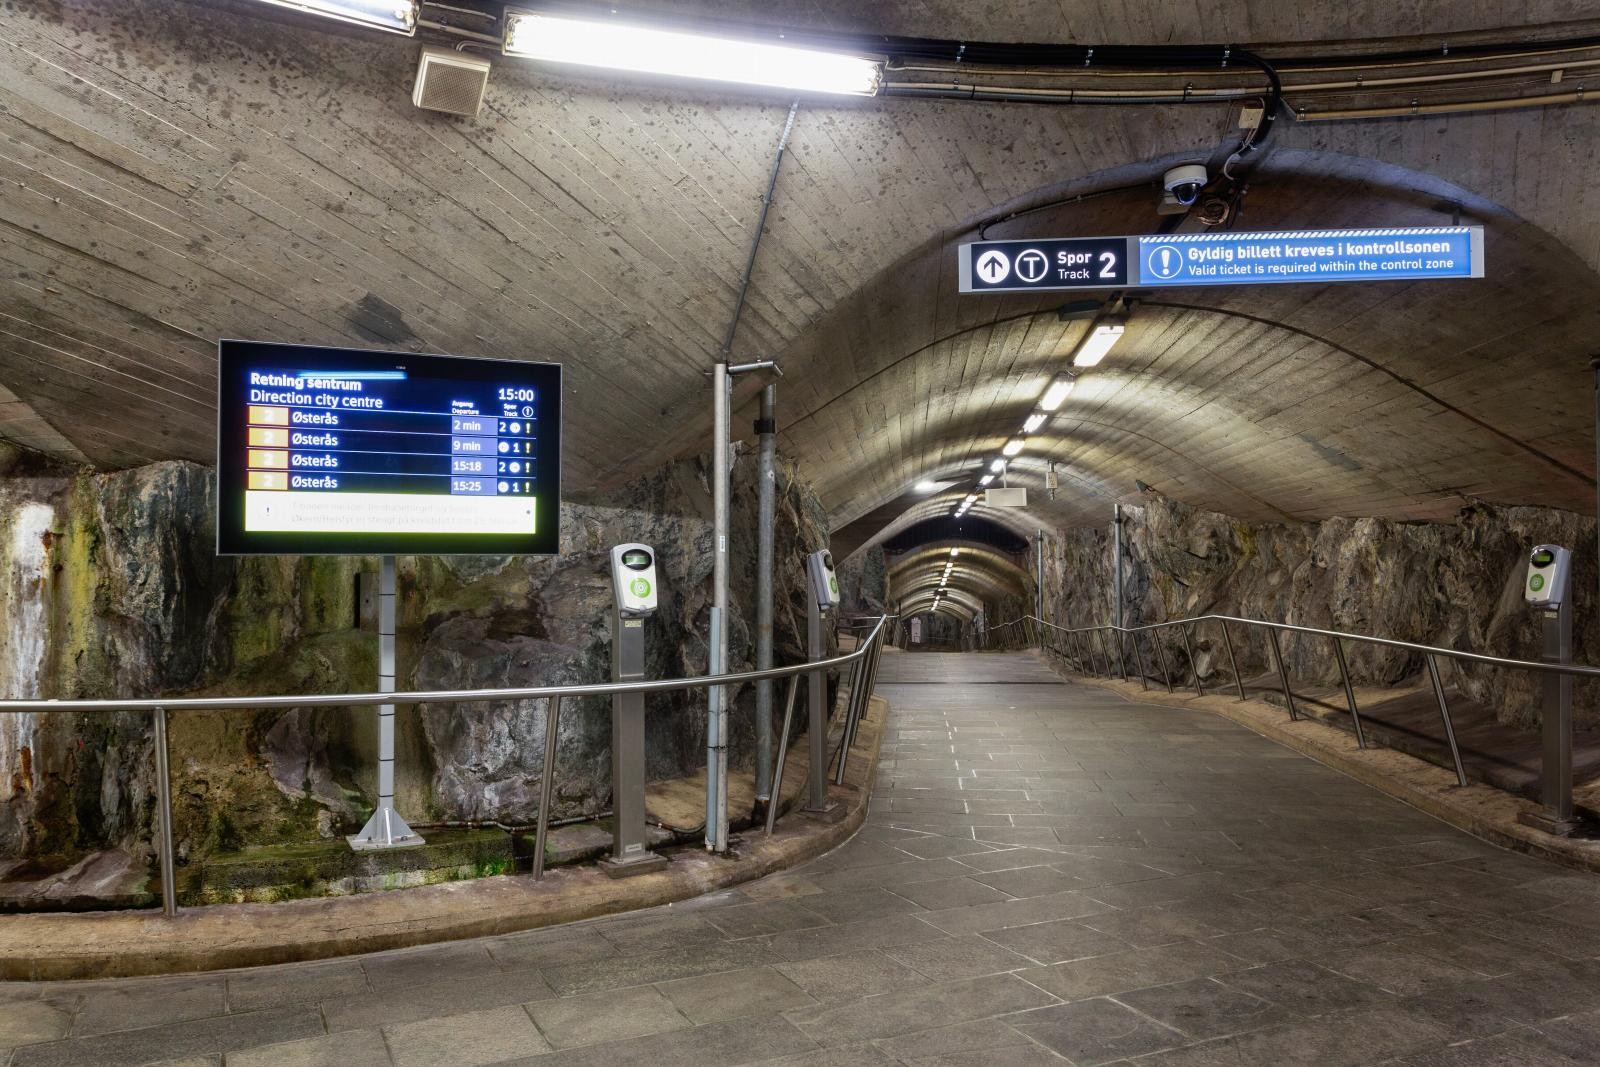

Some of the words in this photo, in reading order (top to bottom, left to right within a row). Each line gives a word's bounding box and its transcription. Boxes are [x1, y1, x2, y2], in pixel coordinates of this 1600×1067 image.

[1188, 248, 1233, 262] Gyldig
[1238, 245, 1281, 259] billett
[1286, 244, 1334, 257] kreves
[1338, 243, 1342, 255] i
[1347, 241, 1450, 255] kontrollsonen
[1058, 252, 1092, 266] Spor
[1099, 252, 1116, 278] 2
[1189, 264, 1216, 275] Valid
[1220, 264, 1251, 274] ticket
[1255, 263, 1264, 273] is
[1268, 261, 1316, 275] required
[1320, 260, 1355, 272] within
[1359, 260, 1377, 270] the
[1381, 258, 1422, 270] control
[1425, 258, 1453, 269] zone
[1058, 269, 1089, 279] Track
[251, 372, 303, 389] Retning
[307, 378, 362, 391] sentrum
[251, 390, 311, 404] Direction
[315, 394, 339, 408] city
[342, 396, 383, 408] centre
[499, 388, 534, 401] 15:00
[292, 412, 338, 424] Østerås
[454, 420, 460, 430] 2
[463, 421, 480, 430] min
[499, 422, 506, 432] 2
[292, 433, 338, 446] Østerås
[454, 441, 460, 450] 9
[463, 441, 480, 451] min
[513, 443, 520, 452] 1
[292, 454, 338, 467] Østerås
[454, 461, 481, 471] 15:18
[499, 462, 506, 472] 2
[292, 476, 338, 488] Østerås
[453, 482, 481, 491] 15:25
[513, 483, 519, 492] 1
